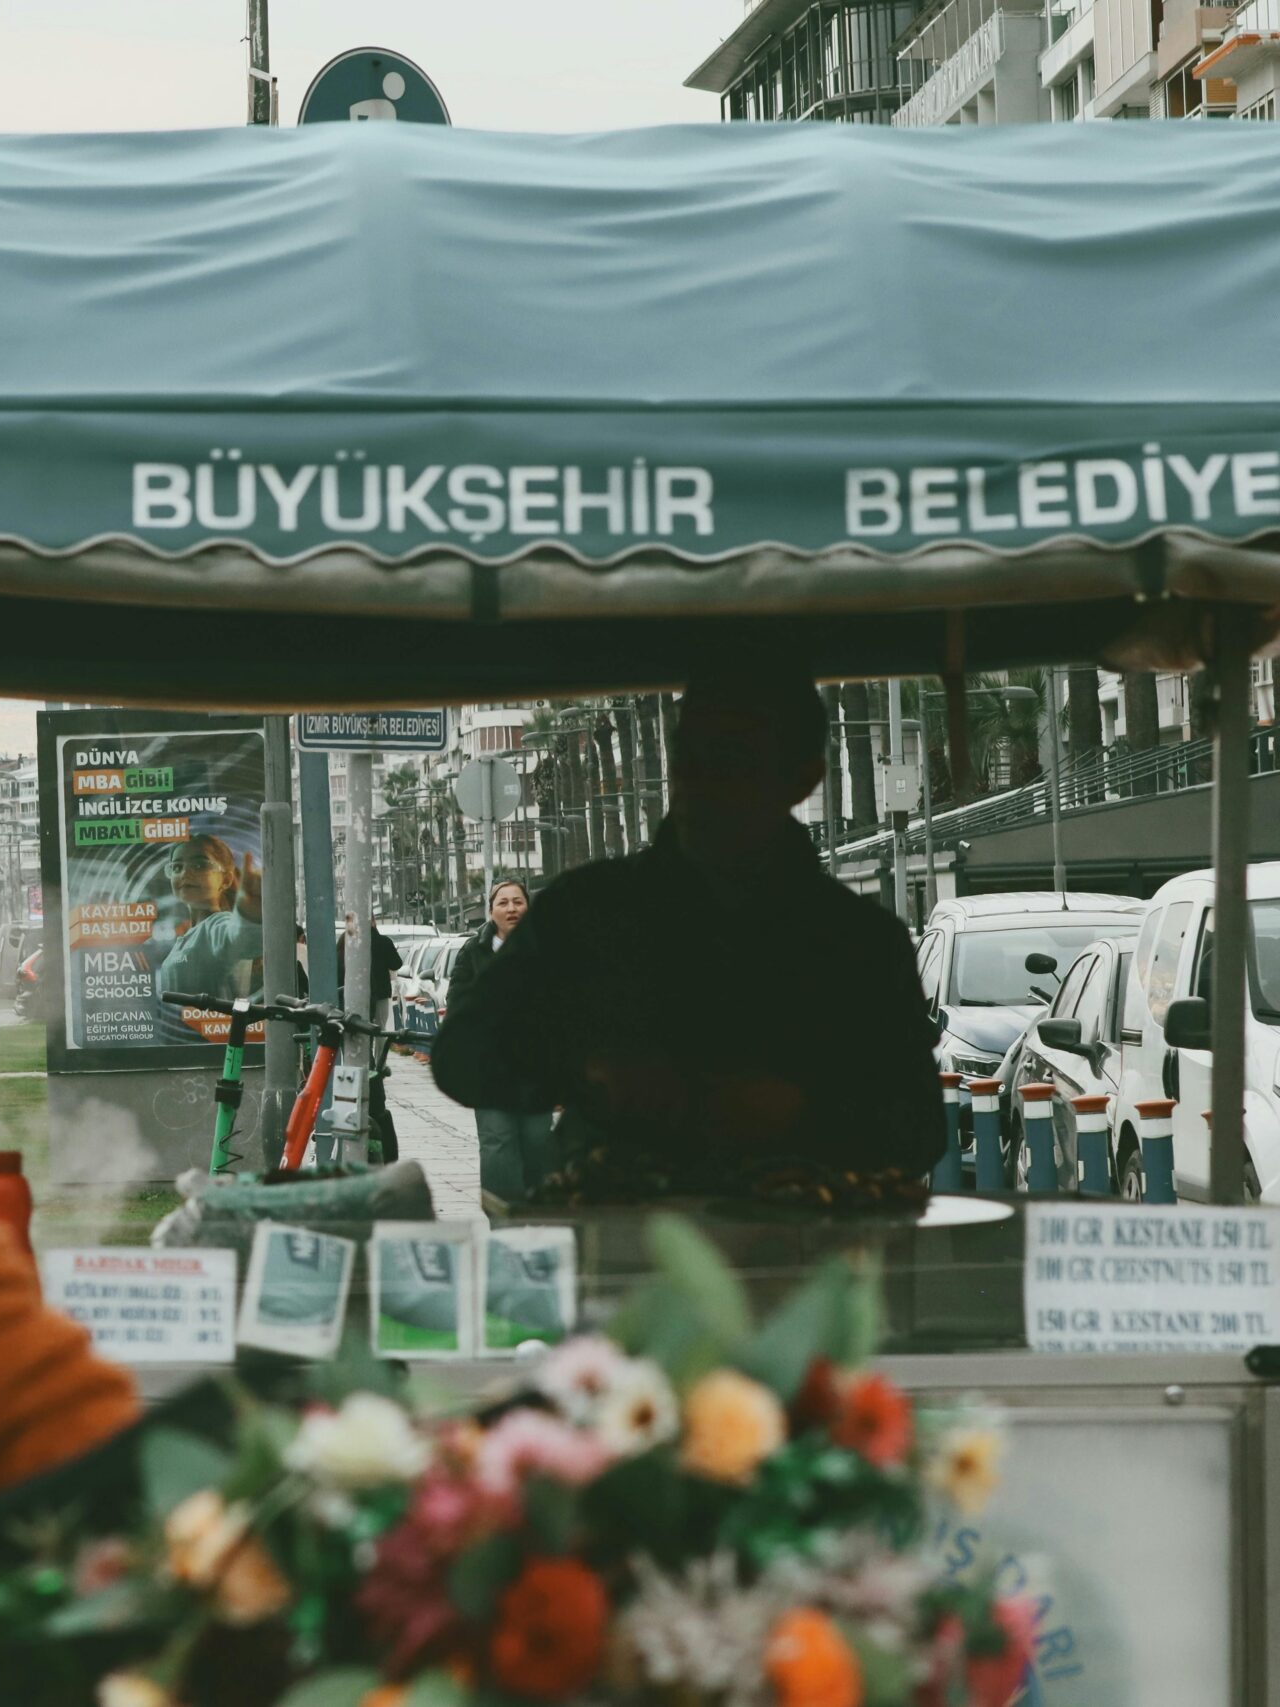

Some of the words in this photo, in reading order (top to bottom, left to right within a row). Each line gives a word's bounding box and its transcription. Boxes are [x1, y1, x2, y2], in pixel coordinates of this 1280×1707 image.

[132, 447, 715, 542] BÜYÜKŞEHİR
[846, 441, 1280, 537] BELEDİYE
[389, 714, 440, 736] BELEDİYESİ
[76, 748, 139, 766] DÜNYA
[77, 774, 122, 790] MBA
[125, 770, 170, 788] GİBİ!
[79, 797, 162, 816] İNGİLİZCE
[167, 797, 227, 815] KONUŞ
[79, 821, 140, 841] MBA'Lİ
[144, 819, 186, 838] GİBİ!
[81, 904, 155, 918] KAYITLAR
[82, 921, 151, 938] BAŞLADI!
[84, 952, 136, 973] MBA
[85, 974, 151, 986] OKULLARI
[85, 986, 152, 999] SCHOOLS
[86, 1011, 146, 1023] MEDICANA
[87, 1033, 128, 1041] EDUCATION
[120, 1024, 154, 1032] GRUBU
[1112, 1217, 1206, 1247] KESTANE
[1246, 1219, 1272, 1249] TL
[1249, 1260, 1272, 1287] TL
[1111, 1309, 1204, 1335] KESTANE
[1244, 1311, 1269, 1336] TL
